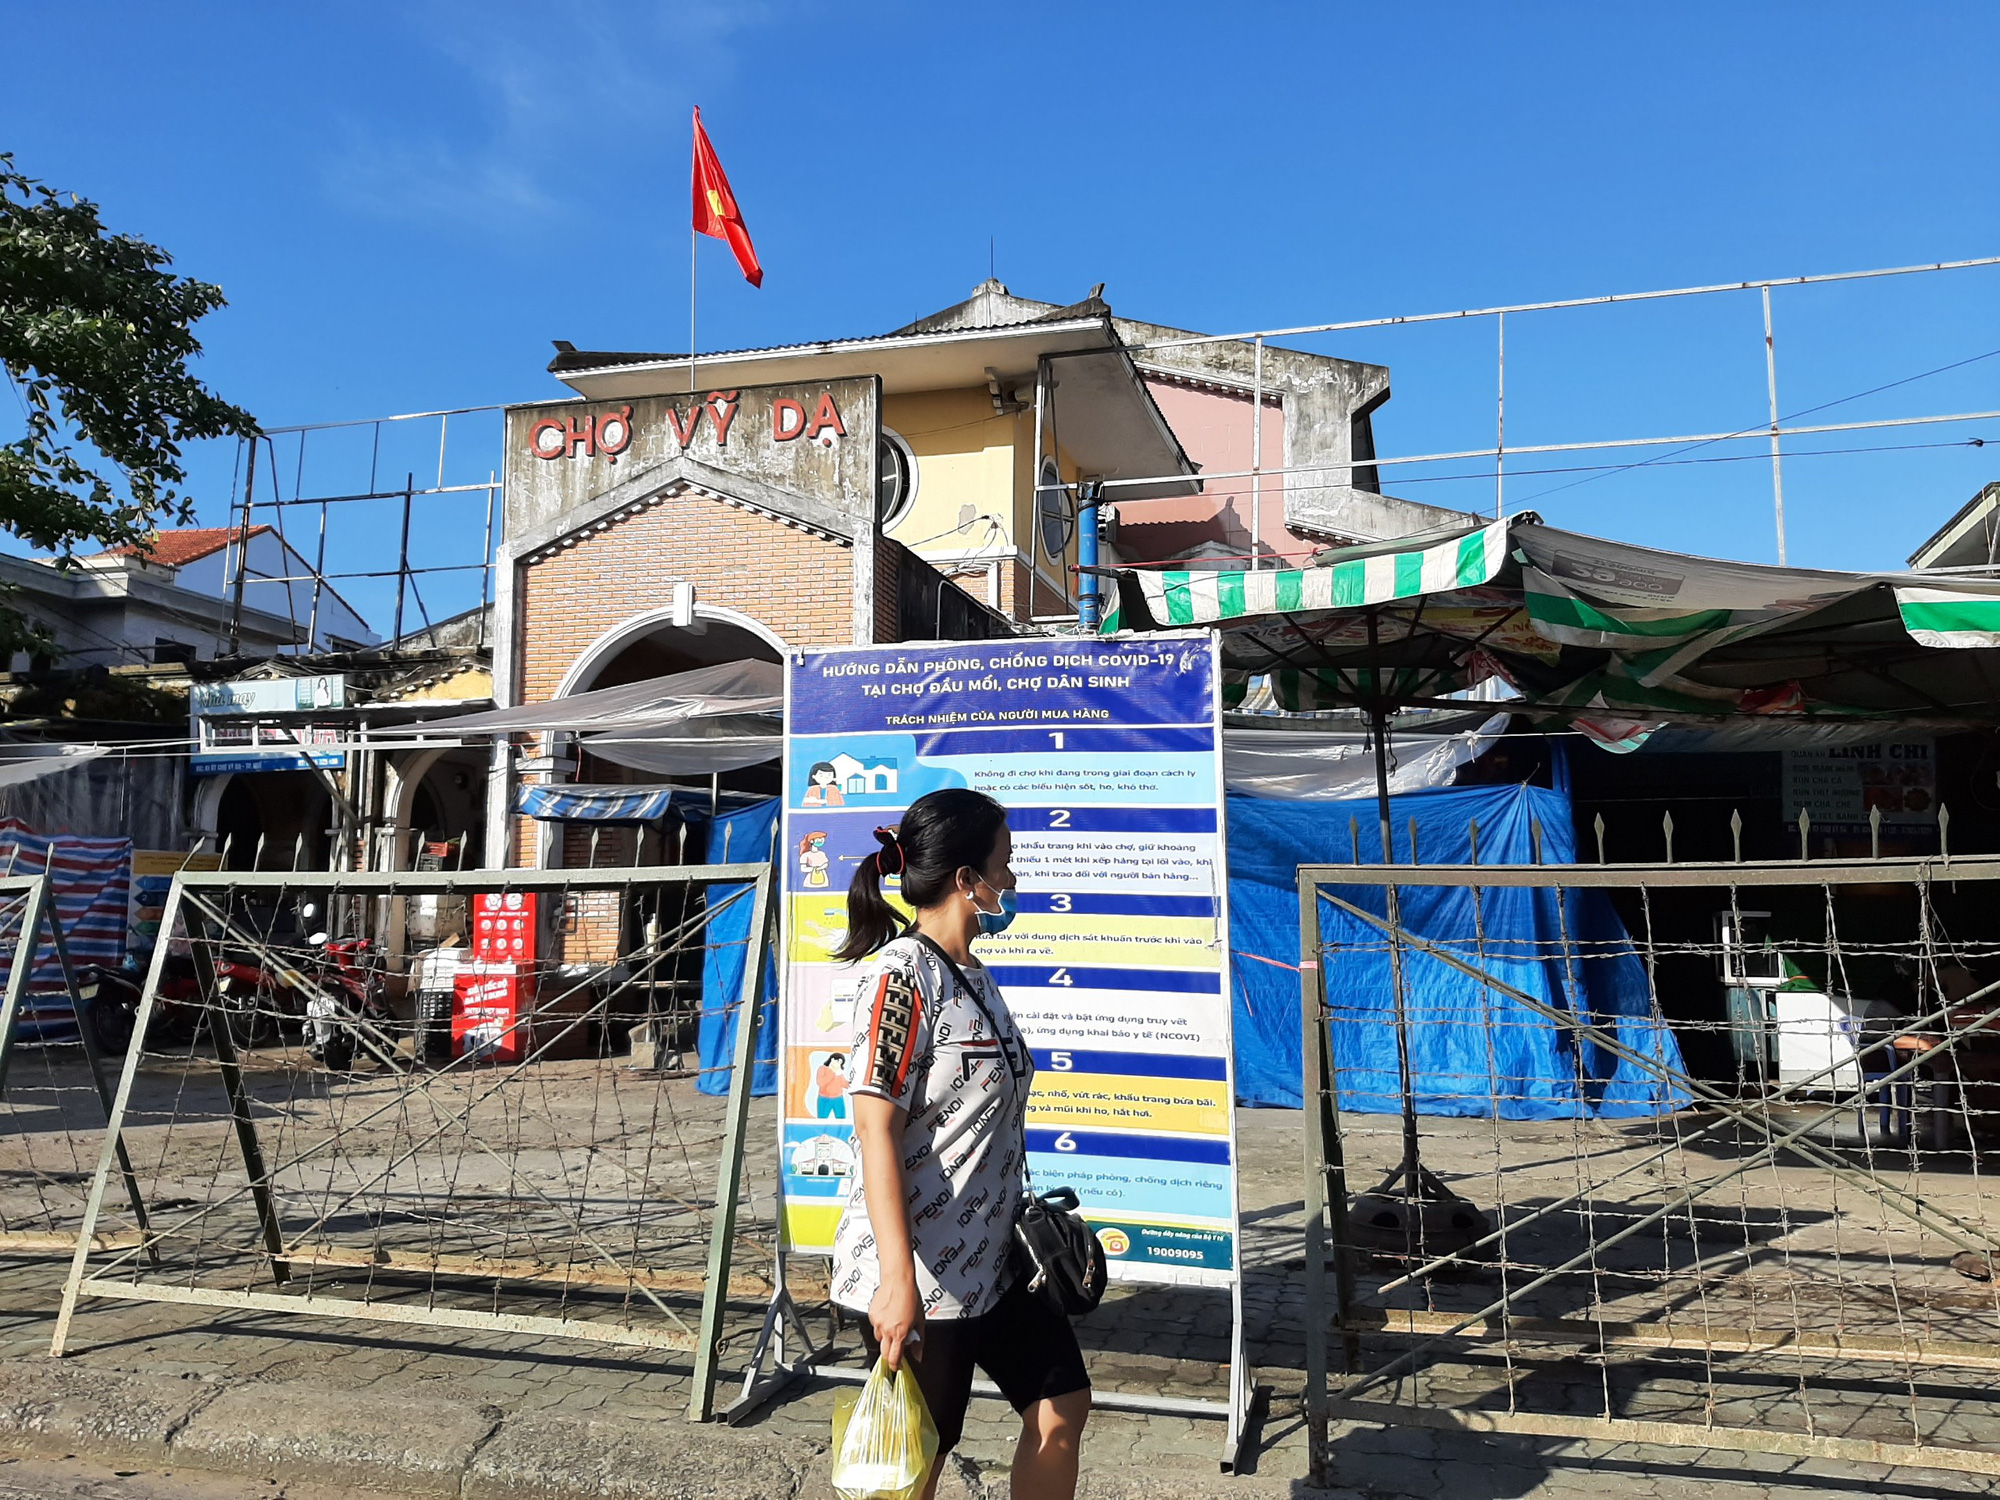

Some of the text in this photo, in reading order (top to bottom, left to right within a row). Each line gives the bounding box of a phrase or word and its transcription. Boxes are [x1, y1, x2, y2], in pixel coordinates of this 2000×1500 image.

[529, 390, 848, 464] CHỢ VỸ DẠ
[823, 652, 1174, 677] HƯỚNG DẪN PHÒNG, CHỐNG DỊCH COVID-19
[862, 674, 1129, 698] TẠI CHỢ ĐẦU MỐI, CHỢ DÂN SINH
[885, 708, 1109, 725] TRÁCH NHIỆM CỦA NGƯỜI MUA HÀNG
[1049, 732, 1065, 750] 1
[1890, 744, 1928, 759] CHI
[1113, 769, 1130, 778] giai
[1054, 783, 1076, 791] hiện
[1049, 810, 1071, 827] 2
[1138, 843, 1155, 852] giữ
[1157, 844, 1196, 852] khoảng
[1050, 894, 1072, 912] 3
[1049, 968, 1073, 986] 4
[1043, 1012, 1059, 1020] đặt
[1076, 1014, 1092, 1022] bật
[1095, 1014, 1115, 1023] ứng
[1118, 1015, 1144, 1024] dụng
[1037, 1027, 1056, 1035] ứng
[1059, 1028, 1084, 1036] dụng
[1156, 1032, 1200, 1042] (NCOVI)
[1051, 1051, 1073, 1071] 5
[1142, 1096, 1170, 1105] trang
[926, 1097, 965, 1133] FENDI
[1054, 1132, 1076, 1151] 6
[939, 1144, 976, 1182] FENDI
[1067, 1171, 1093, 1180] pháp
[1096, 1173, 1131, 1183] phòng,
[1135, 1176, 1167, 1186] chống
[1170, 1178, 1191, 1186] dịch
[1195, 1180, 1222, 1190] riêng
[1106, 1189, 1125, 1198] có).
[913, 1188, 953, 1227] FENDI
[957, 1187, 990, 1228] FENDI
[930, 1237, 967, 1279] FENDI
[959, 1236, 990, 1277] FENDI
[1147, 1246, 1204, 1260] 19009095
[838, 1266, 863, 1299] FENDI
